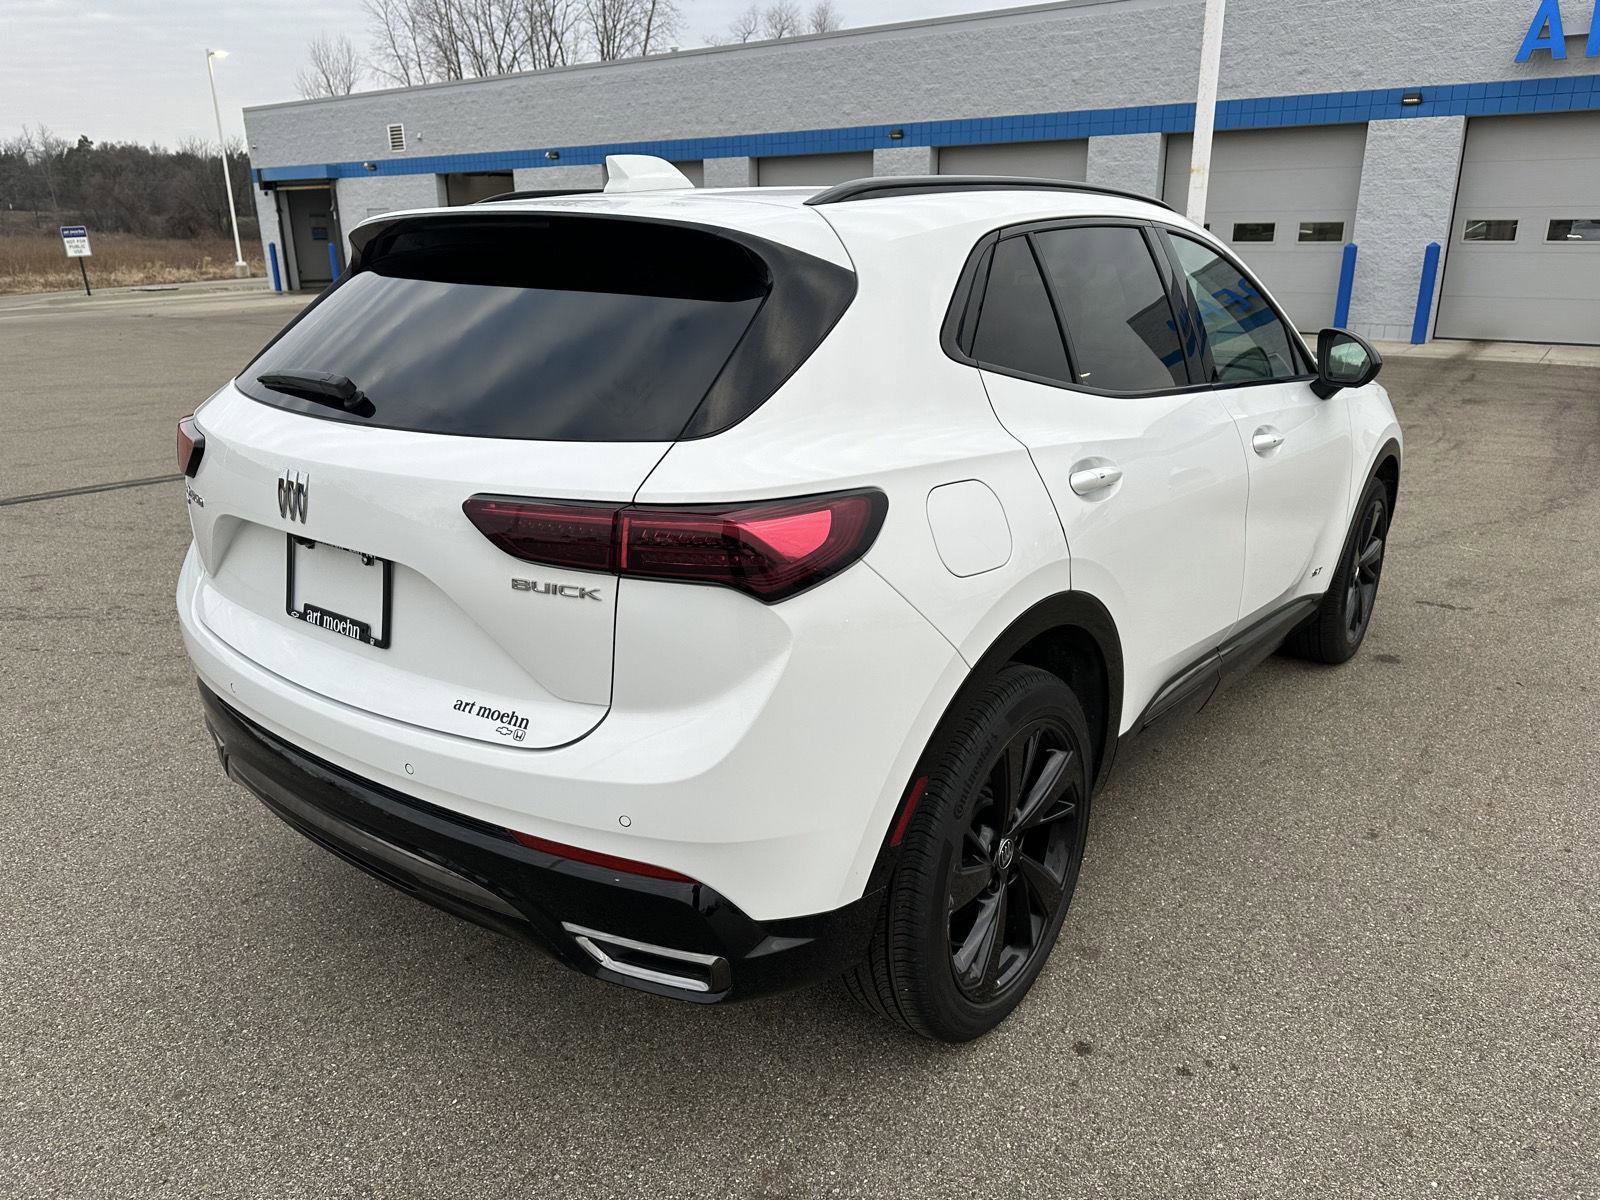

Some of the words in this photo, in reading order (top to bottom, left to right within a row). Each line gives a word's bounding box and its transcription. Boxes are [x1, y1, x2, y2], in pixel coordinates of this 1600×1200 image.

[1514, 0, 1600, 63] A
[511, 578, 602, 601] BUICK
[306, 609, 321, 626] art
[323, 615, 360, 640] moehn
[453, 699, 476, 714] art
[477, 705, 530, 730] moehn
